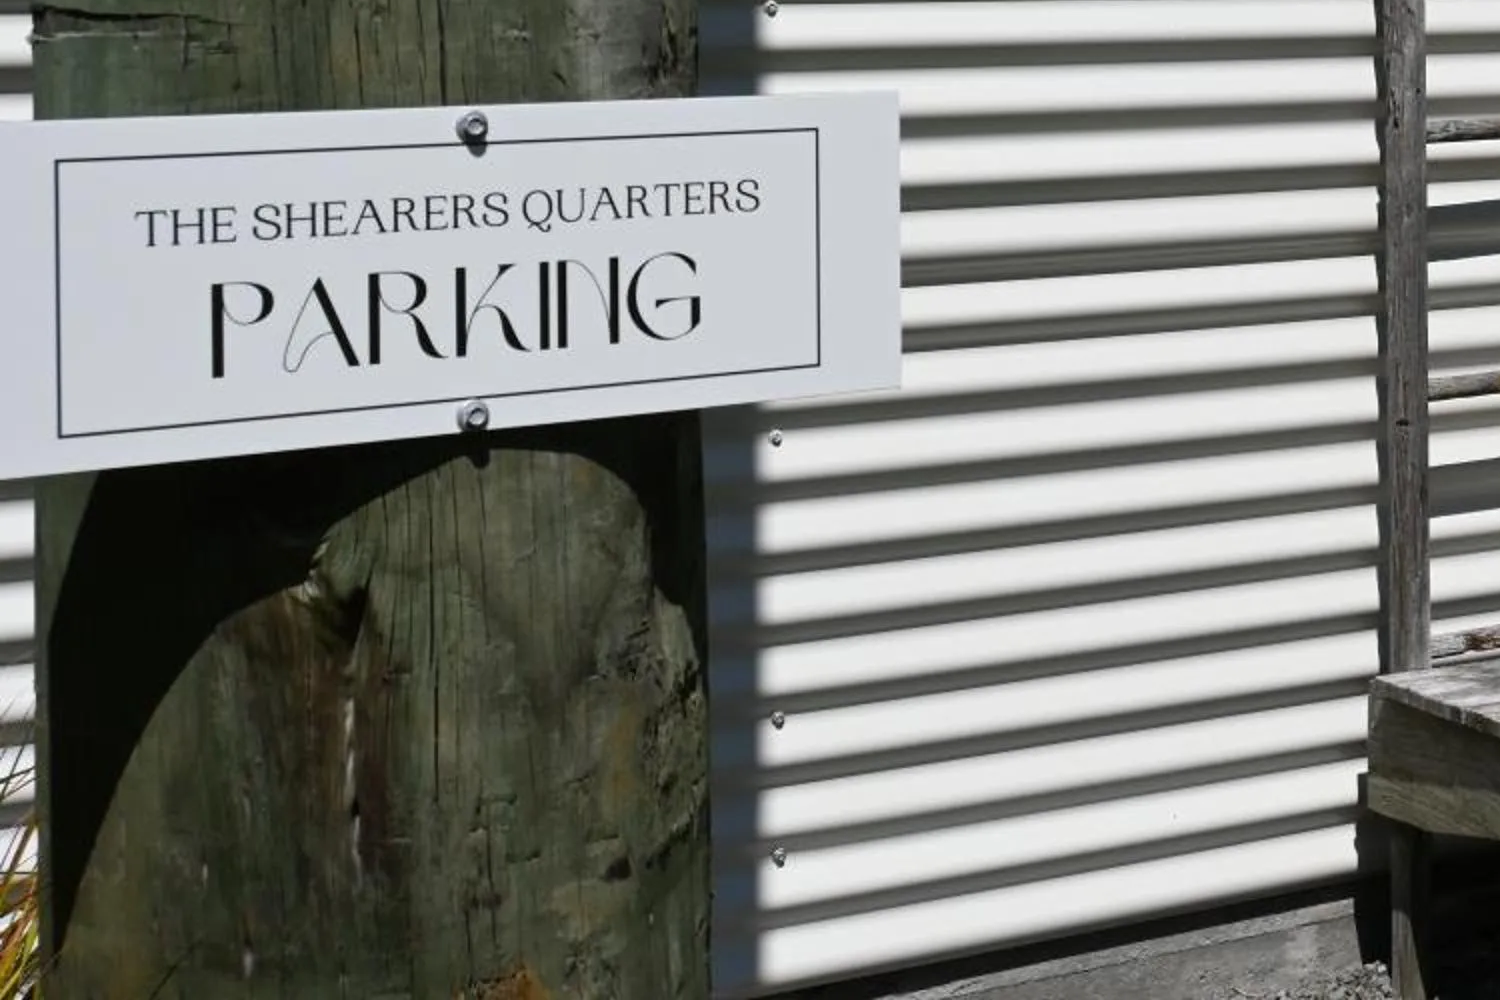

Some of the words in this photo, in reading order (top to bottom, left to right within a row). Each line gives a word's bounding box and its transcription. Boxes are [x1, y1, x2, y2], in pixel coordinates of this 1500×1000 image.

[134, 206, 237, 247] THE
[251, 192, 509, 241] SHEARERS
[521, 178, 761, 233] QUARTERS
[210, 251, 701, 379] PARKING
